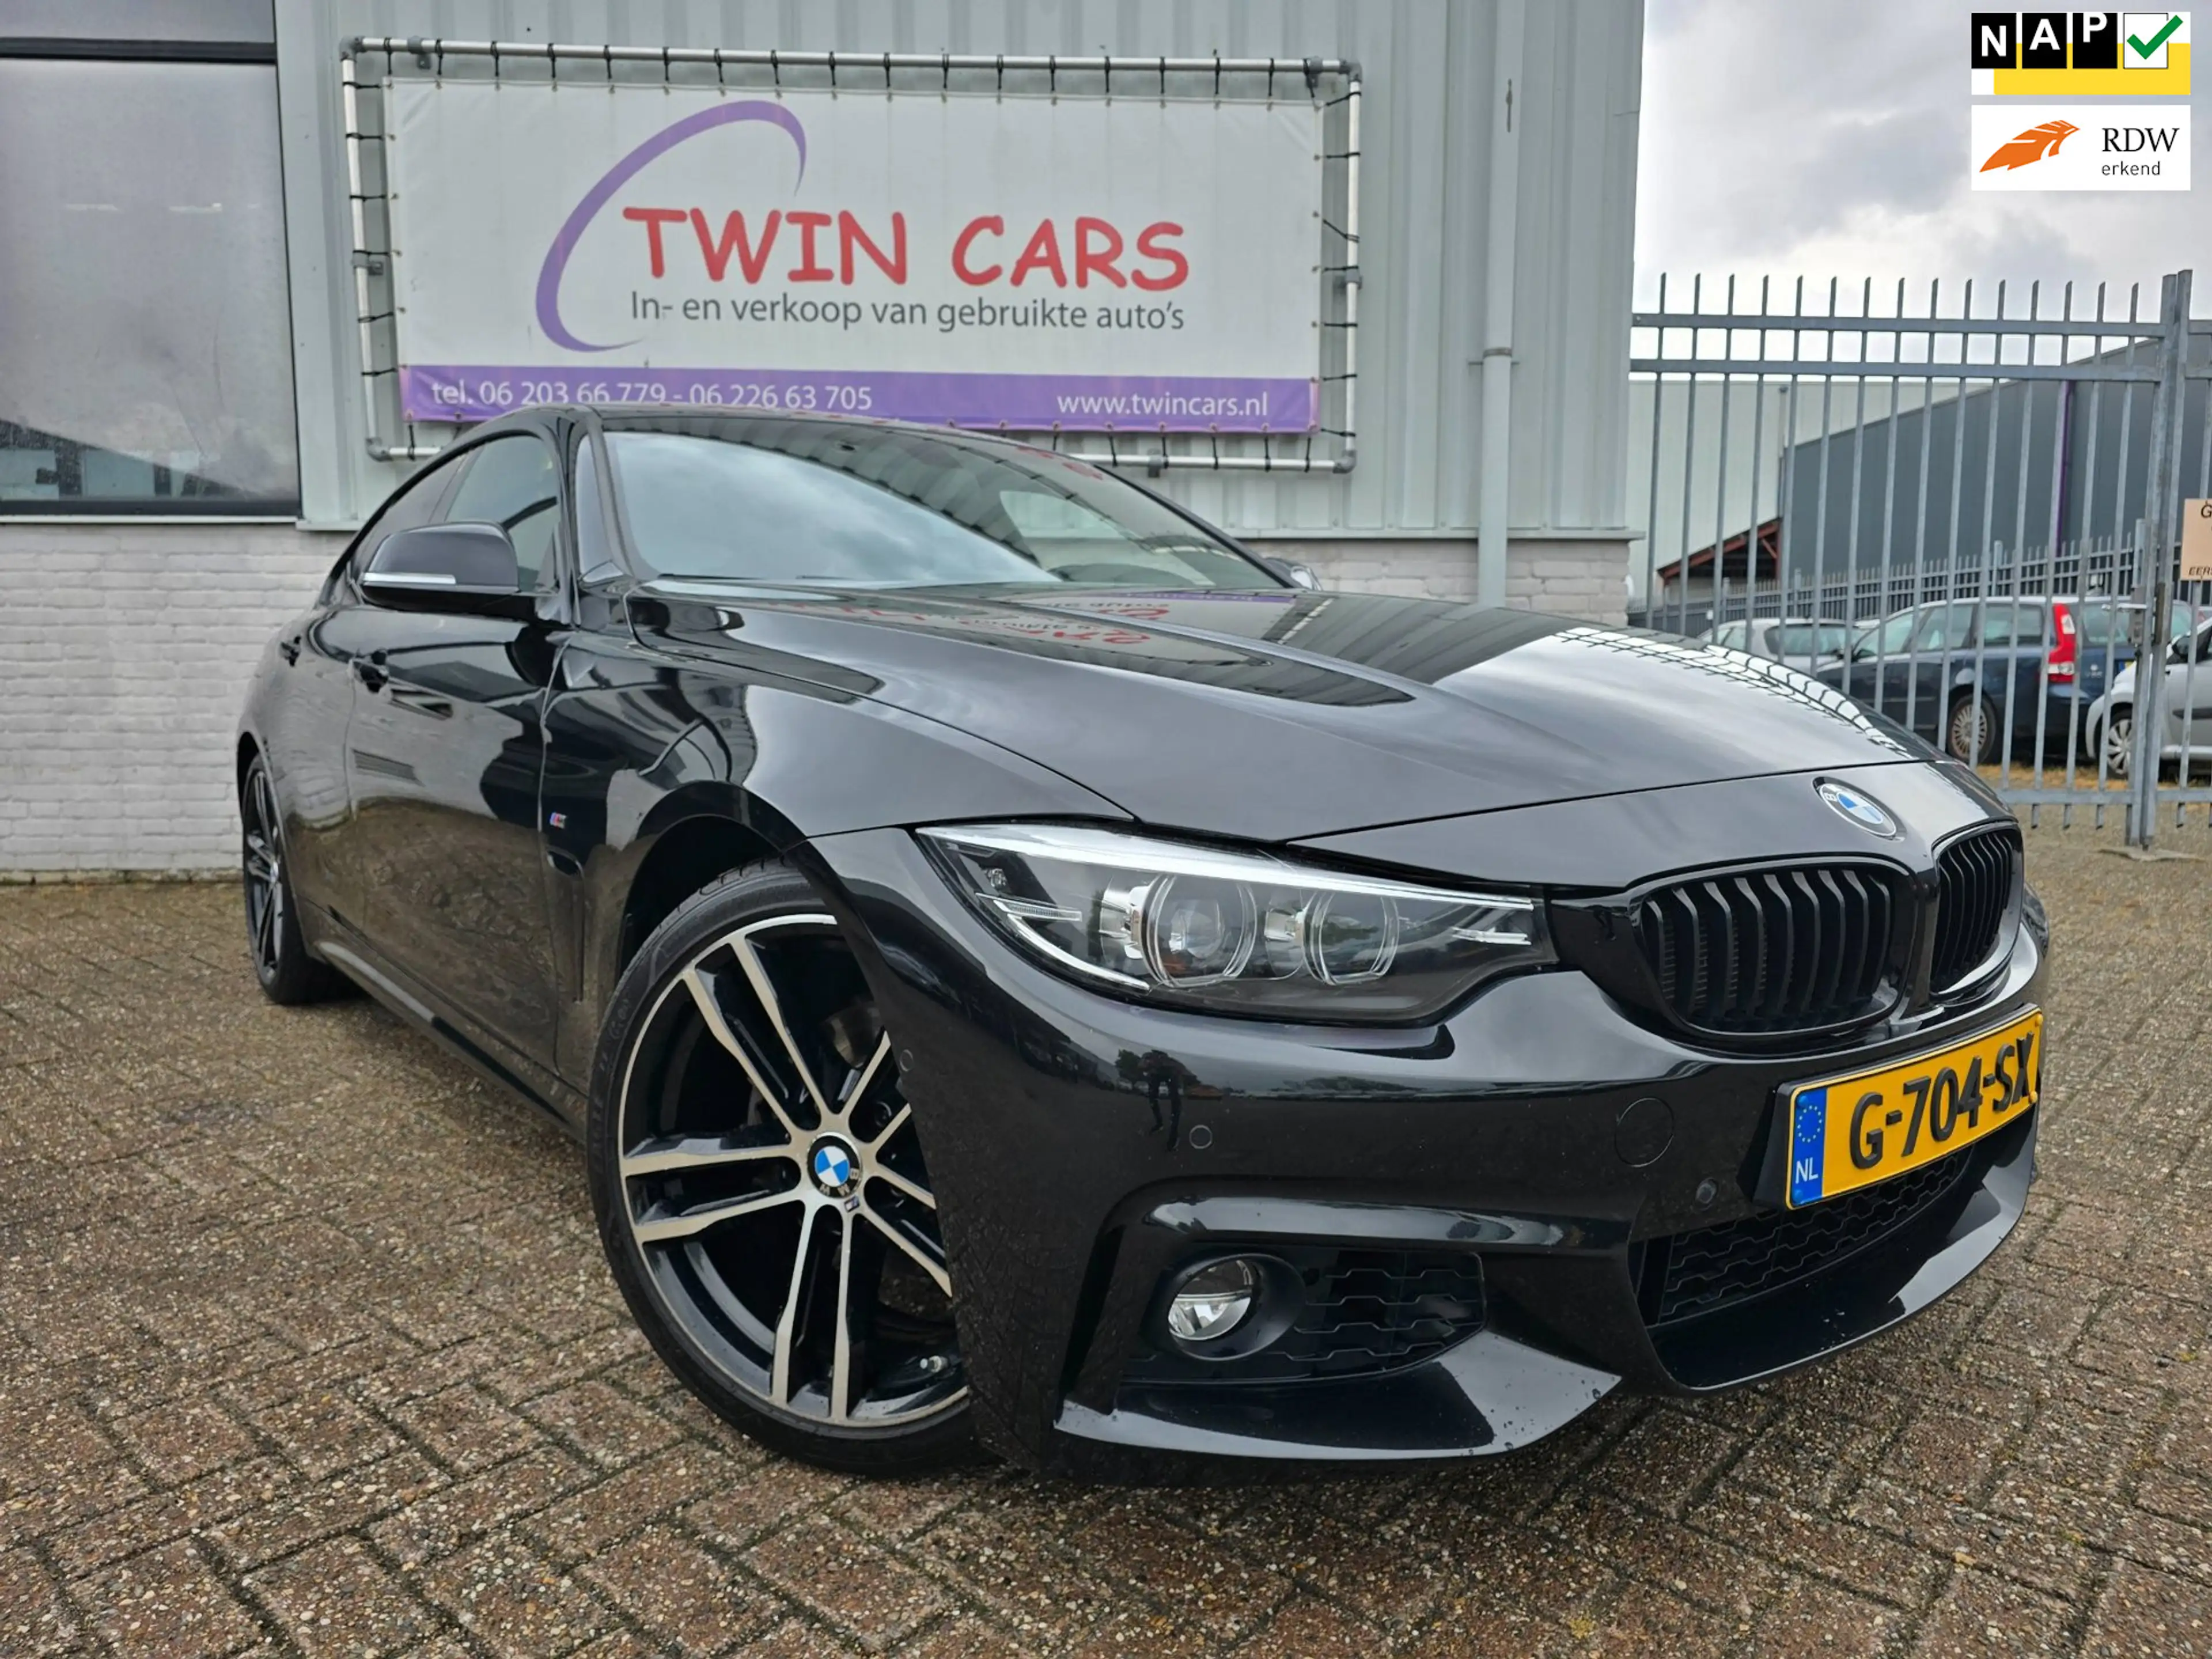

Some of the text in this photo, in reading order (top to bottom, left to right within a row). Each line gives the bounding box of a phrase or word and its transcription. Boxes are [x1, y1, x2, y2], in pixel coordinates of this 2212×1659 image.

[623, 207, 1189, 291] TWIN CARS
[632, 291, 1184, 333] In- en verkoop van gebruikte auto's
[431, 379, 474, 404] tel.
[479, 381, 514, 405] 06
[521, 381, 570, 404] 203
[577, 382, 610, 403] 66
[616, 383, 666, 403] 779
[690, 384, 722, 404] 06
[730, 384, 778, 409] 226
[785, 385, 817, 409] 63
[824, 386, 873, 410] 705
[1057, 392, 1268, 418] www.twincars.nl
[1849, 1032, 2035, 1169] G-704-SX
[1795, 1157, 1819, 1184] NL
